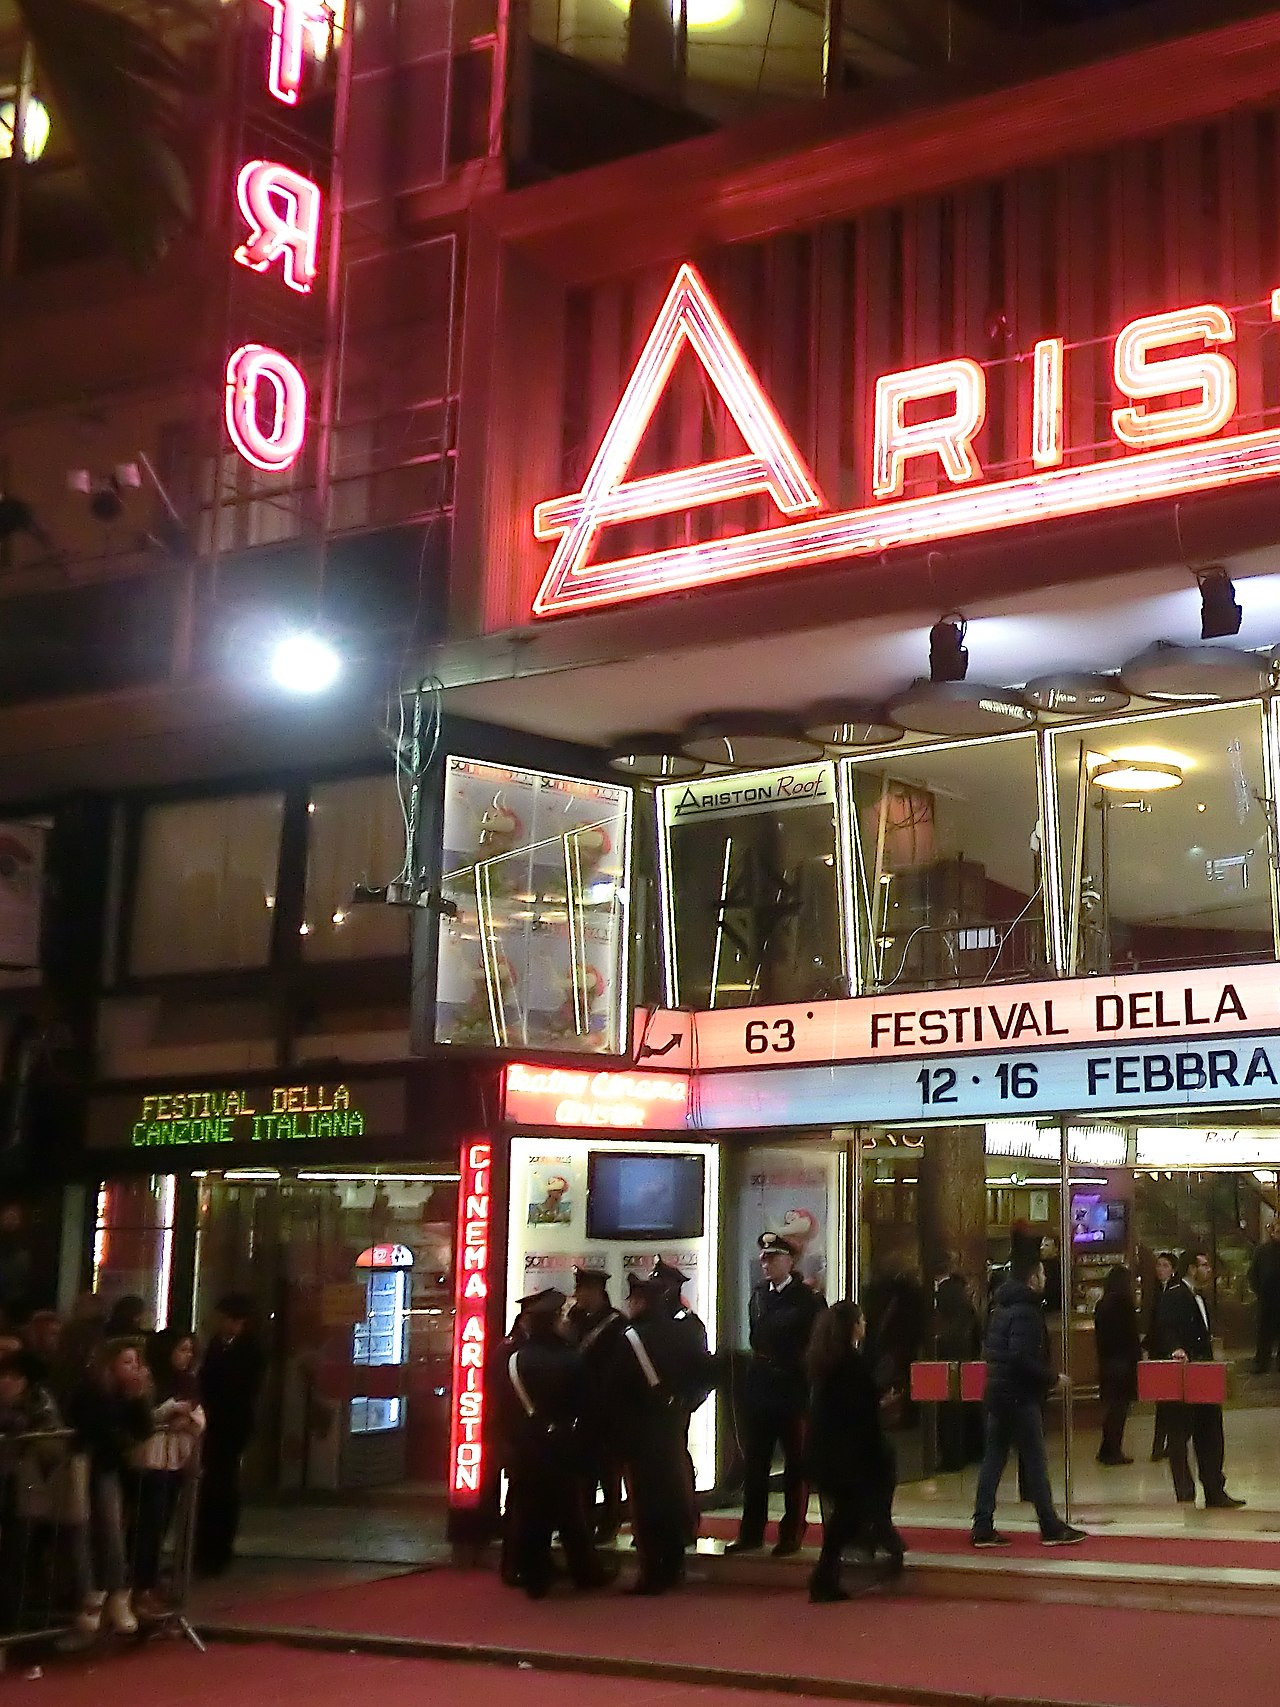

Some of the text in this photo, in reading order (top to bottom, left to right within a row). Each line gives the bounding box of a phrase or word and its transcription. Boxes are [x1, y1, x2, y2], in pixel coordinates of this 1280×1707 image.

[674, 769, 827, 817] ARISTON Roof
[871, 999, 1070, 1049] FESTIVAL
[1096, 984, 1248, 1033] DELLA
[132, 1110, 366, 1147] CANZONE ITALIANA
[142, 1083, 351, 1121] FESTIVAL DELLA
[463, 1144, 492, 1299] CINEMA
[454, 1315, 484, 1491] ARISTON
